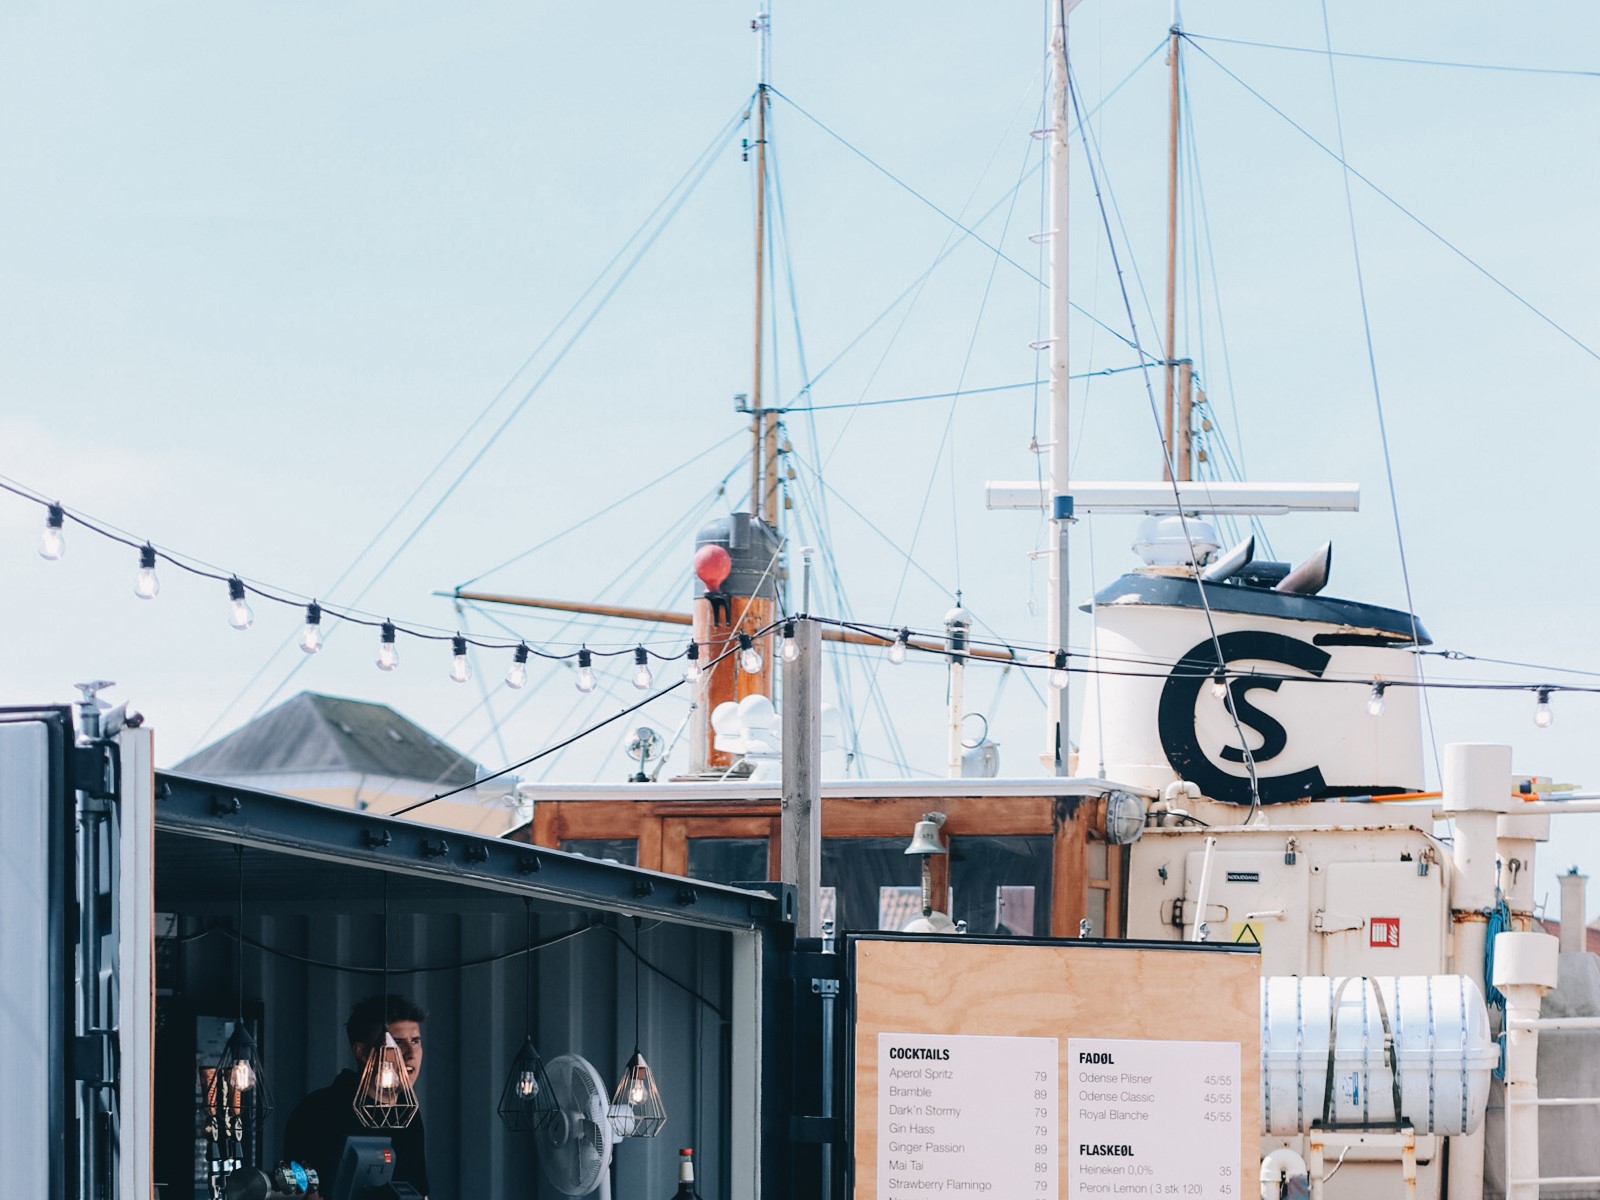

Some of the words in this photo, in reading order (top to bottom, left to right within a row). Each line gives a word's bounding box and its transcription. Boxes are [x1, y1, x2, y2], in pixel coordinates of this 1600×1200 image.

[890, 1048, 949, 1060] COCKTAILS
[1080, 1053, 1114, 1064] FADØL
[889, 1067, 922, 1080] Aperol
[925, 1068, 953, 1080] Spritz
[1035, 1071, 1047, 1082] 79
[1079, 1072, 1118, 1083] Odense
[1121, 1073, 1152, 1084] Pilsner
[1204, 1075, 1232, 1087] 45/55
[890, 1086, 932, 1097] Bramble
[1034, 1089, 1047, 1100] 89
[1079, 1090, 1118, 1101] Odense
[1120, 1090, 1155, 1102] Classic
[1204, 1093, 1232, 1104] 45/55
[925, 1105, 961, 1118] Stormy
[1035, 1108, 1047, 1118] 79
[1080, 1109, 1106, 1121] Royal
[1110, 1109, 1148, 1120] Blanche
[1204, 1112, 1232, 1122] 45/55
[889, 1123, 906, 1133] Gin
[910, 1124, 935, 1134] Hass
[1035, 1126, 1047, 1136] 79
[889, 1142, 923, 1155] Ginger
[926, 1142, 965, 1153] Passion
[1035, 1144, 1047, 1154] 89
[1080, 1144, 1134, 1156] FLASKEØL
[889, 1160, 907, 1170] Mai
[910, 1160, 923, 1170] Tai
[1035, 1162, 1047, 1173] 89
[1080, 1164, 1125, 1175] Heineken
[1220, 1166, 1231, 1176] 35
[889, 1178, 943, 1192] Strawberry
[947, 1179, 991, 1192] Flamingo
[1035, 1181, 1047, 1191] 79
[1080, 1182, 1111, 1193] Peroni
[1113, 1184, 1147, 1194] Lemon
[1165, 1184, 1179, 1194] stk
[1220, 1185, 1231, 1194] 45
